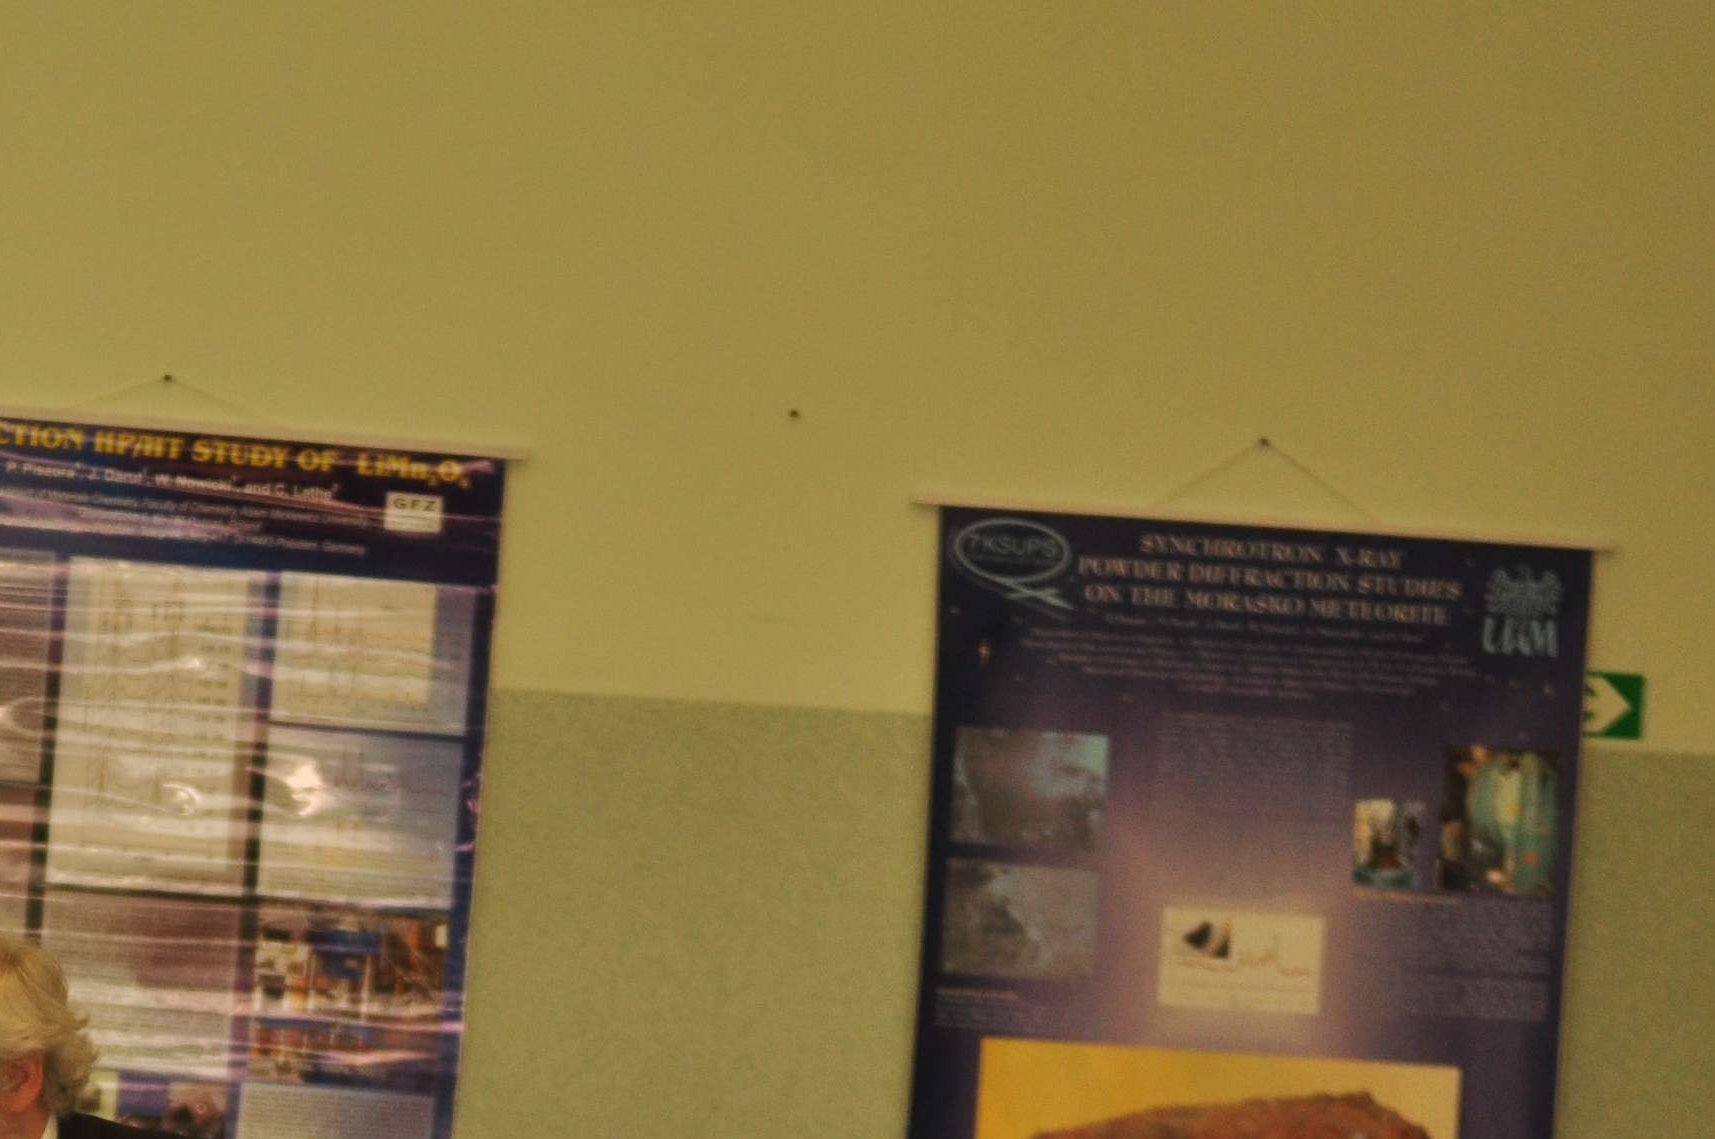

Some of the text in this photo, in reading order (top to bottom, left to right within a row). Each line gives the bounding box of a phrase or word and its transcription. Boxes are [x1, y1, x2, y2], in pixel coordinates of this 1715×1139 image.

[192, 439, 291, 471] STUDY
[296, 448, 339, 473] OF
[1140, 533, 1404, 569] SYNCHROTRON X-RAY
[1078, 555, 1464, 600] POWDER DIFFRACTION STUDIES
[1084, 583, 1450, 626] ON THE MORASKO METEORITE
[1482, 616, 1559, 659] UAM
